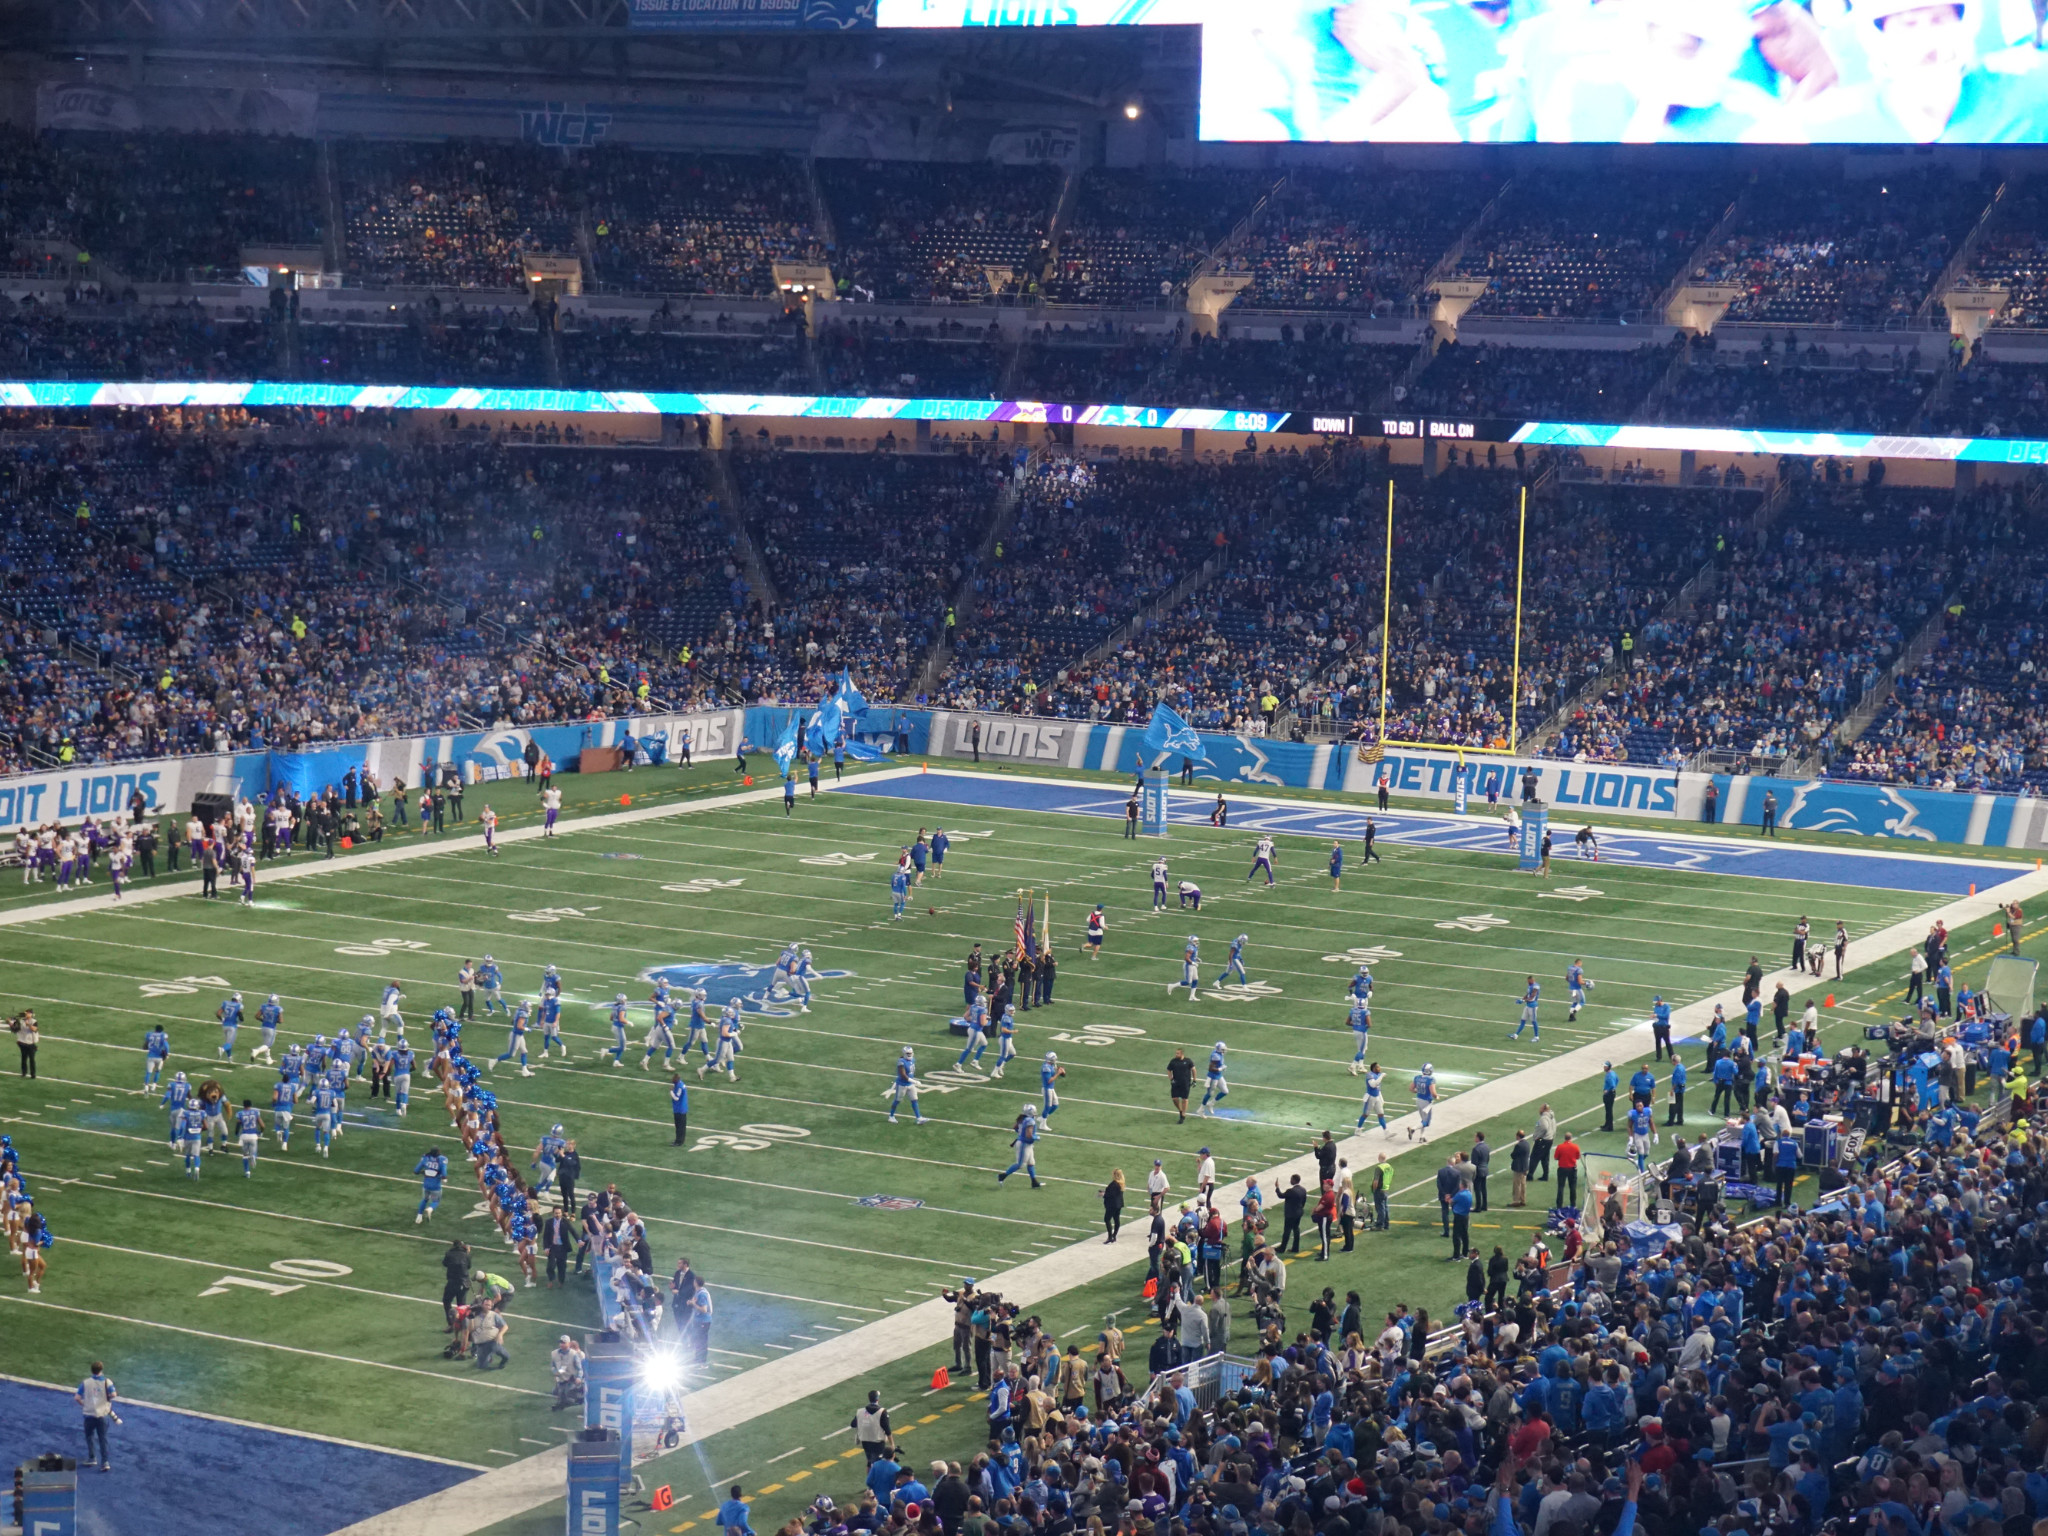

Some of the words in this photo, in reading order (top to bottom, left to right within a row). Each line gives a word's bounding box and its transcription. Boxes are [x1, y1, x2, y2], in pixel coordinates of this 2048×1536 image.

[518, 110, 613, 147] WCF
[1062, 406, 1072, 422] 0
[1147, 409, 1157, 425] 0
[1313, 418, 1345, 432] DOWN
[1383, 421, 1398, 434] TO
[1399, 421, 1415, 435] GO
[1430, 422, 1456, 437] BALL
[1458, 424, 1474, 438] ON
[645, 717, 728, 754] IONS
[954, 719, 1064, 760] LIONS
[58, 771, 161, 818] LIONS
[1455, 776, 1465, 812] LIONS
[1556, 769, 1677, 812] LIONS
[1146, 788, 1156, 823] LIONS
[1258, 844, 1269, 853] 47
[1525, 822, 1537, 858] LIONS
[1536, 887, 1605, 901] 10
[1434, 916, 1511, 932] 20
[334, 938, 432, 956] 50
[1322, 948, 1404, 965] 30
[1048, 1024, 1147, 1046] 50
[697, 1124, 811, 1150] 30
[1844, 1133, 1860, 1154] FOX
[212, 1259, 353, 1296] 10
[938, 1368, 949, 1383] 10
[660, 1486, 673, 1507] G
